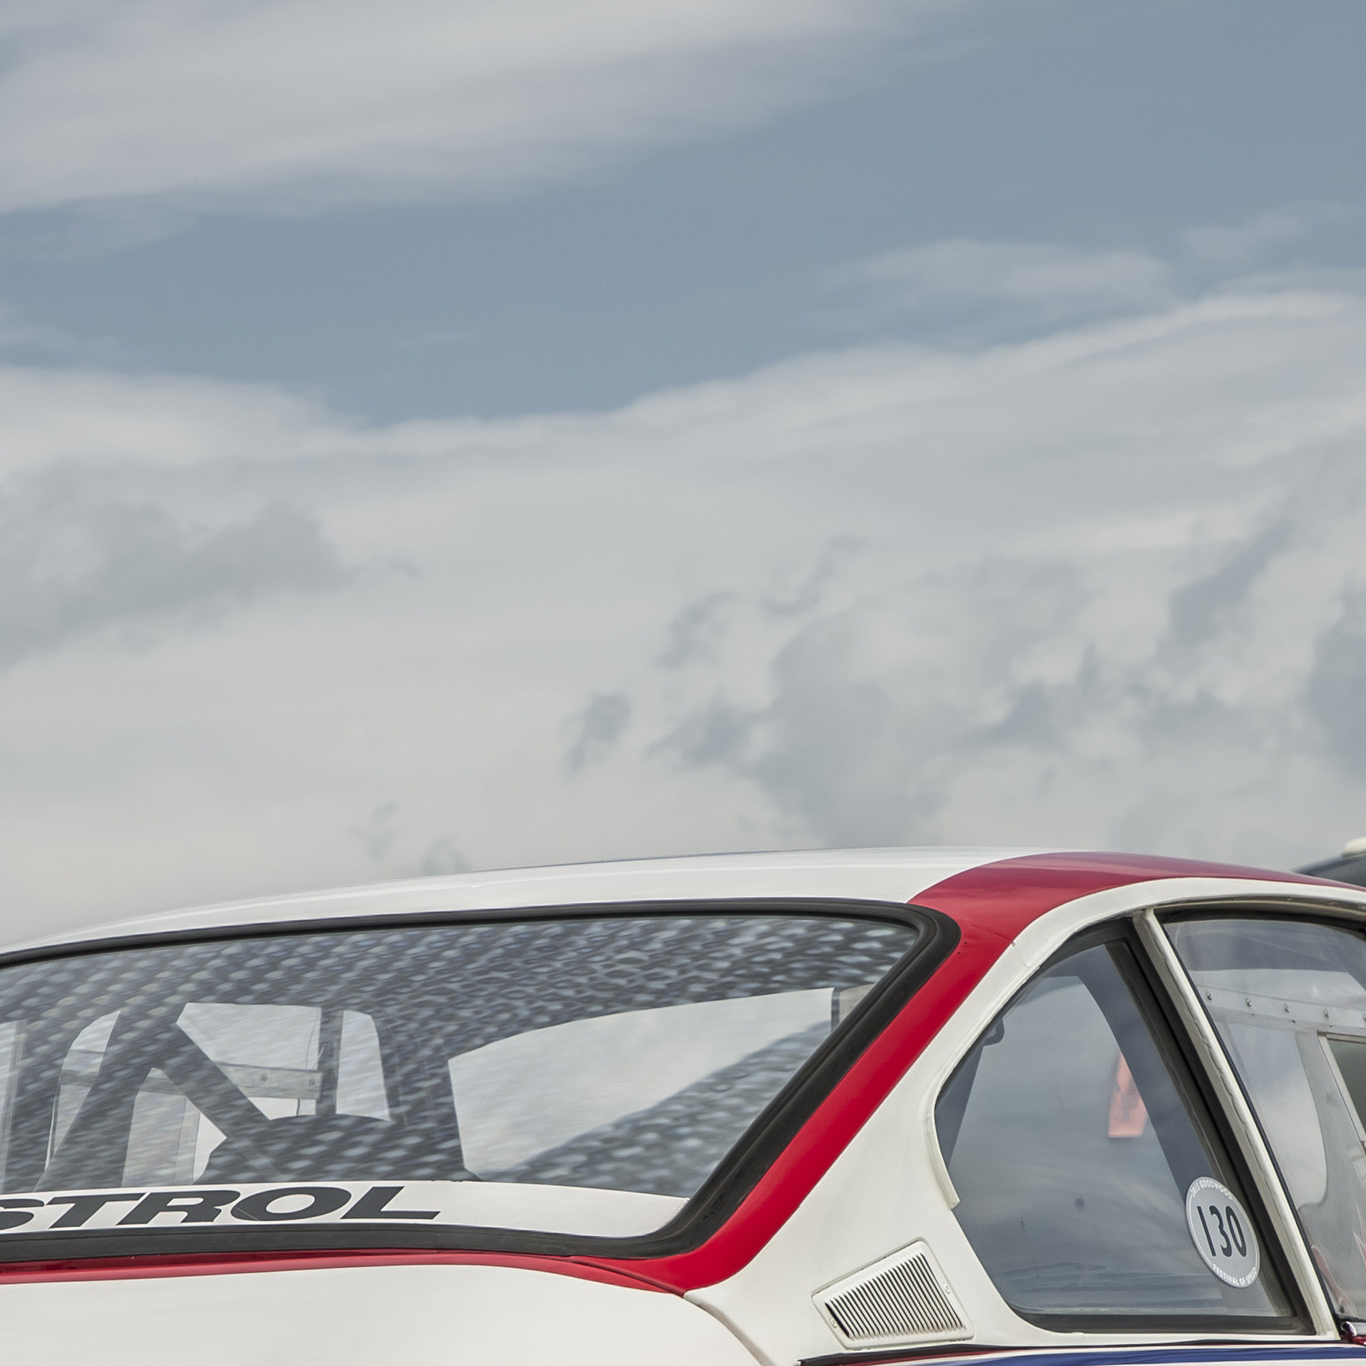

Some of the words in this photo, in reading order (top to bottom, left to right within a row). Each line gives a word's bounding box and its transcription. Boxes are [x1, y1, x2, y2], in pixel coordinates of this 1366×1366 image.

[1199, 1179, 1233, 1200] GOODWOOD
[1196, 1205, 1247, 1257] 130
[1212, 1263, 1240, 1286] FESTIVAL
